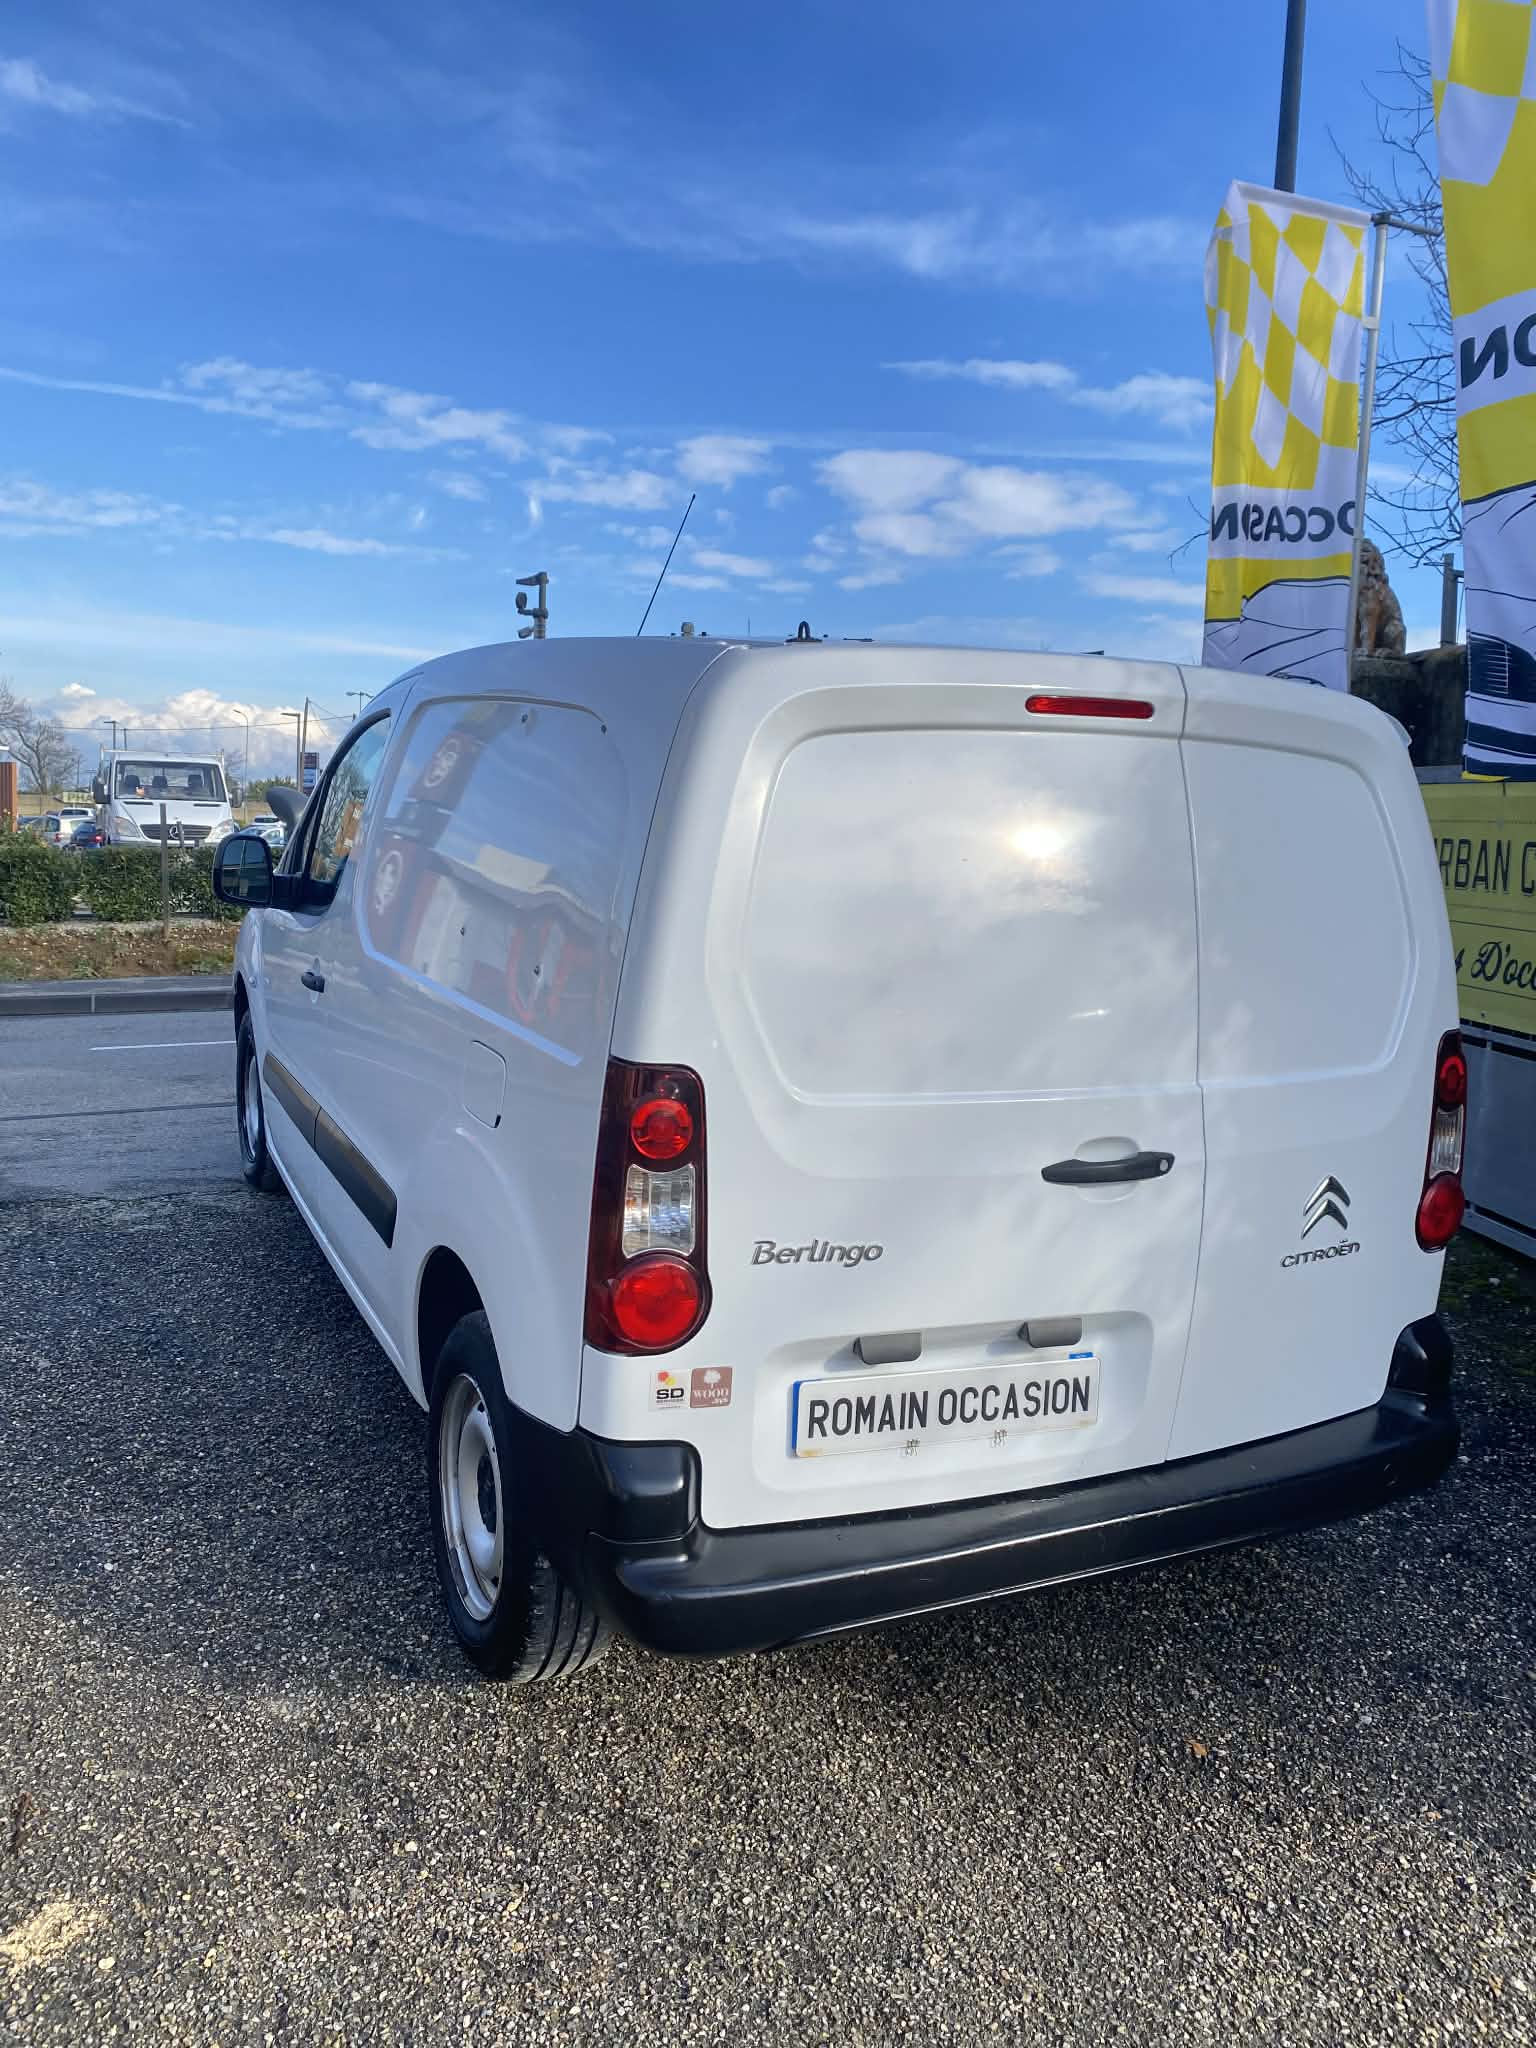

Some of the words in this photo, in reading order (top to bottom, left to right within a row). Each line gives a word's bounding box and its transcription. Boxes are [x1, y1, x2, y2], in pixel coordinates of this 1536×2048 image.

[1434, 838, 1510, 892] RBAN
[752, 1239, 884, 1267] Berlingo
[656, 1387, 684, 1399] SD
[808, 1390, 929, 1439] ROMAIN
[937, 1375, 1090, 1426] OCCASION
